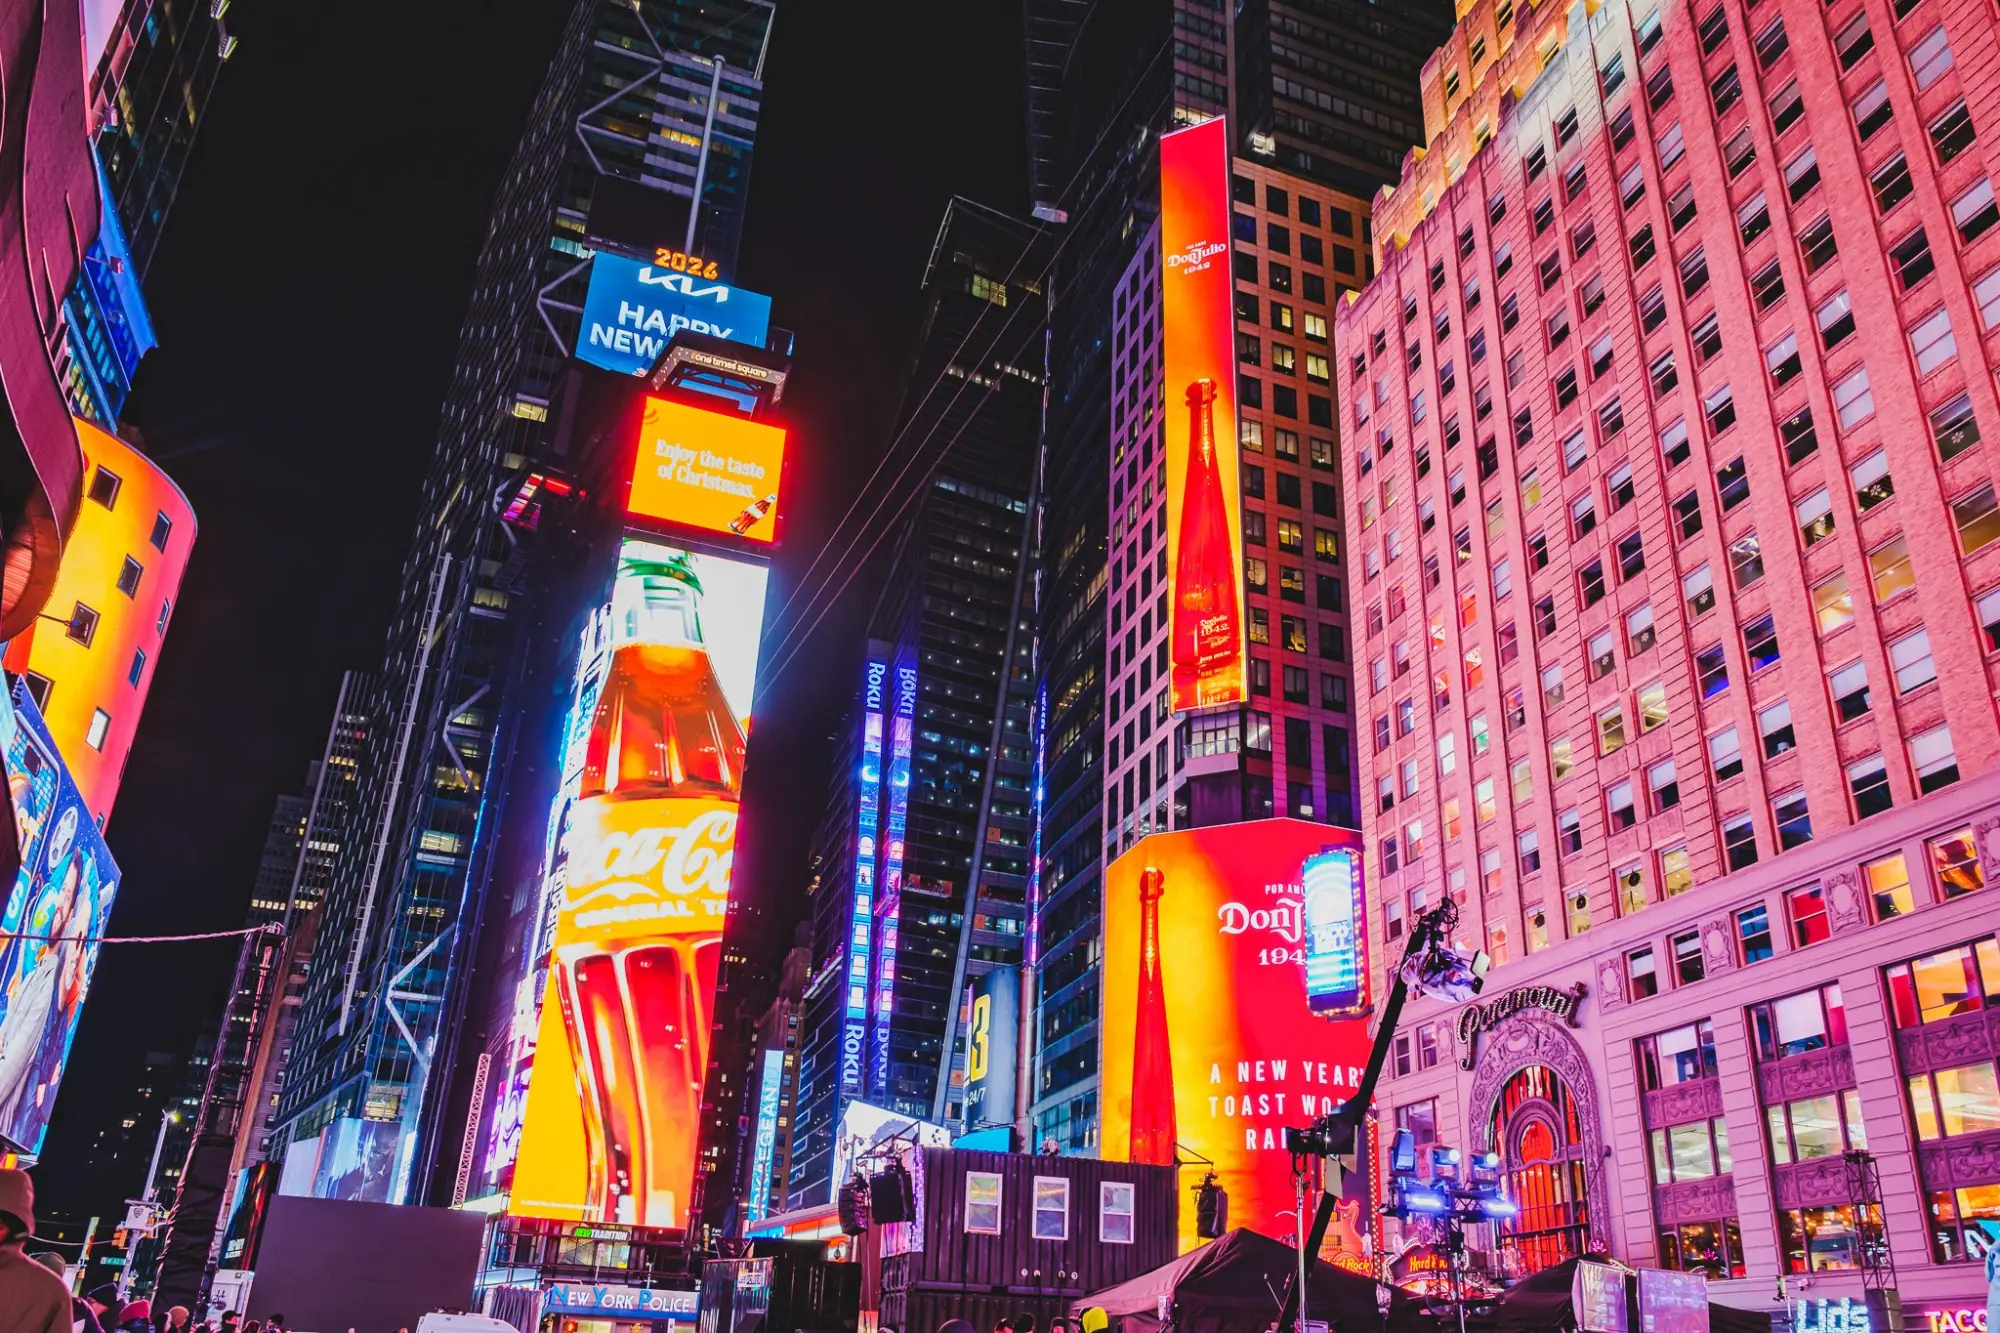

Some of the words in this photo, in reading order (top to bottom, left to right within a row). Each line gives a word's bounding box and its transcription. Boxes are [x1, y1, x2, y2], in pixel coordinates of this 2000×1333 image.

[655, 248, 719, 280] 2026
[589, 322, 664, 359] NEW
[695, 353, 712, 365] one
[712, 357, 737, 370] times
[737, 362, 767, 379] square
[655, 438, 698, 467] Enjoy
[700, 449, 725, 470] the
[727, 456, 766, 480] taste
[657, 463, 677, 480] of
[676, 464, 757, 499] Christmas.
[1265, 883, 1284, 895] POR
[1287, 883, 1304, 894] AM
[1258, 947, 1307, 967] 194
[1457, 981, 1588, 1070] Paramount
[1209, 1063, 1221, 1084] A
[1237, 1059, 1287, 1083] NEW
[1302, 1060, 1364, 1088] YEAR'
[968, 1086, 987, 1107] 24/7
[1208, 1093, 1286, 1118] TOAST
[1301, 1094, 1346, 1116] WO
[1245, 1127, 1287, 1150] RAI
[1346, 1257, 1370, 1273] Rock
[1409, 1254, 1430, 1272] Hard
[550, 1284, 591, 1306] NEW
[593, 1286, 633, 1311] YORK
[638, 1289, 691, 1312] POLICE
[1796, 1297, 1870, 1333] Lids
